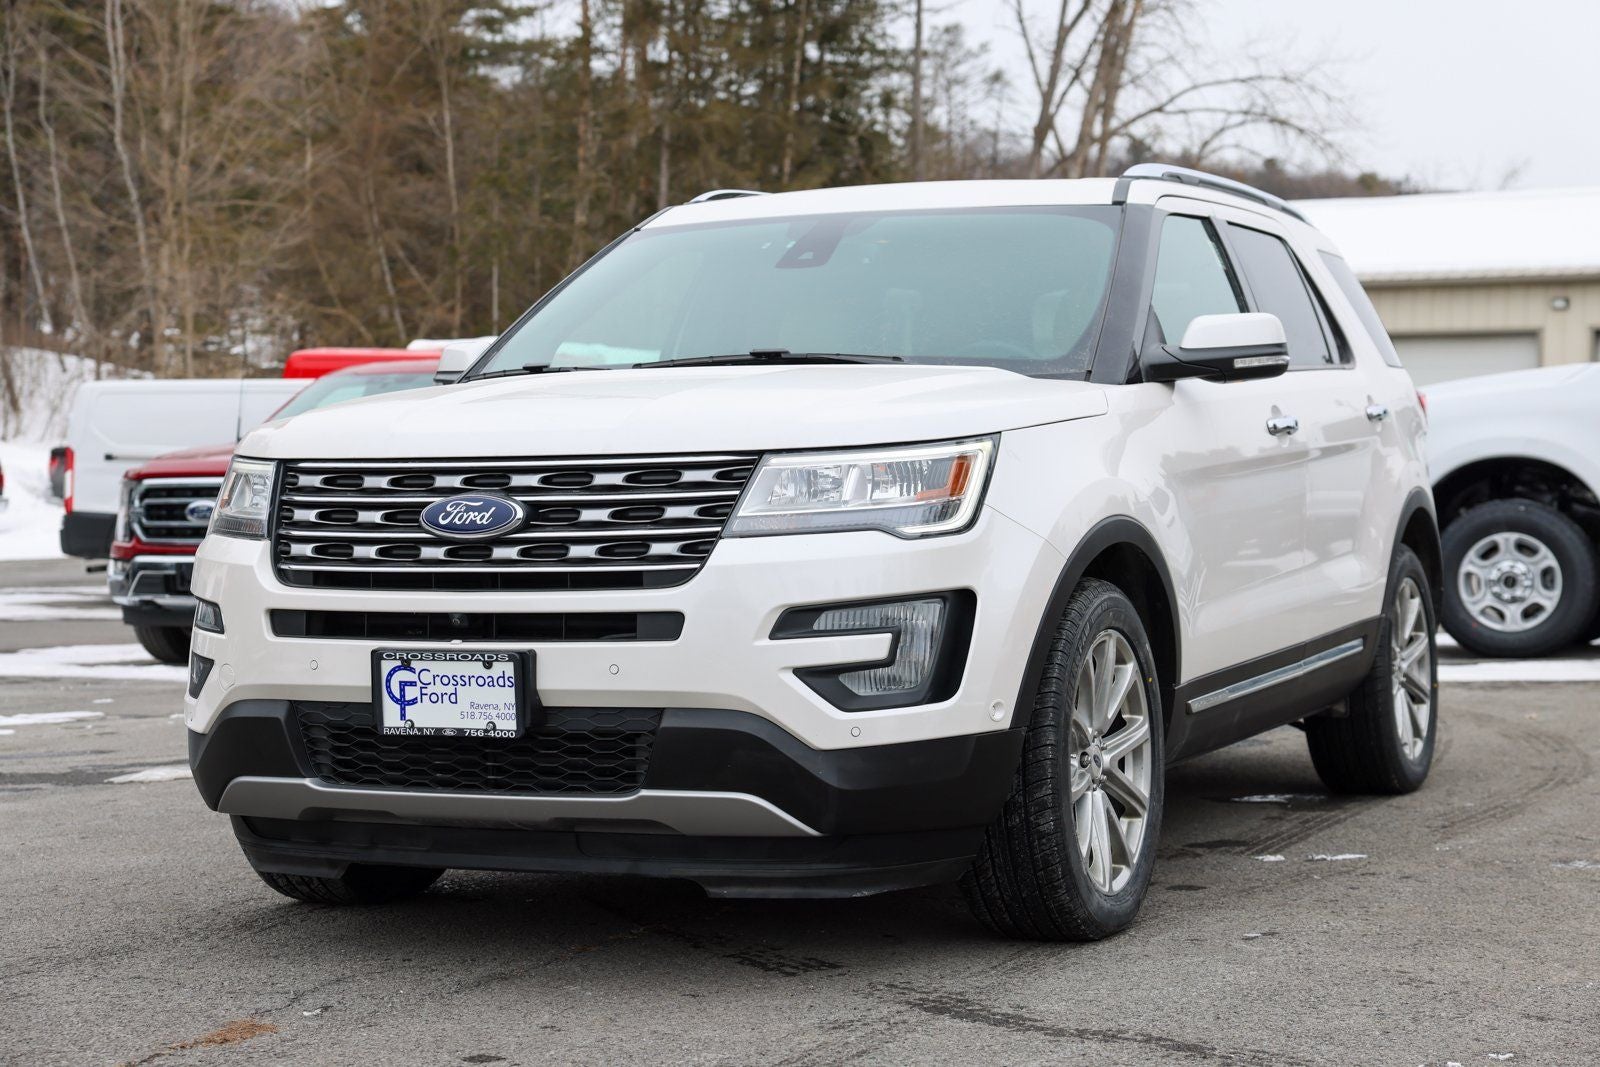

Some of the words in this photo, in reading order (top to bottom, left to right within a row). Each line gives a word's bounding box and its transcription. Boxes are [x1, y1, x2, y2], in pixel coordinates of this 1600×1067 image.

[438, 500, 497, 525] Ford
[382, 652, 510, 662] CROSSROADS
[417, 668, 515, 688] Crossroads
[419, 686, 458, 705] Ford
[469, 702, 502, 711] Ravena,
[503, 702, 516, 711] NY
[459, 711, 516, 721] 518.756.4000
[423, 728, 436, 736] NY
[463, 729, 516, 738] 756-4000
